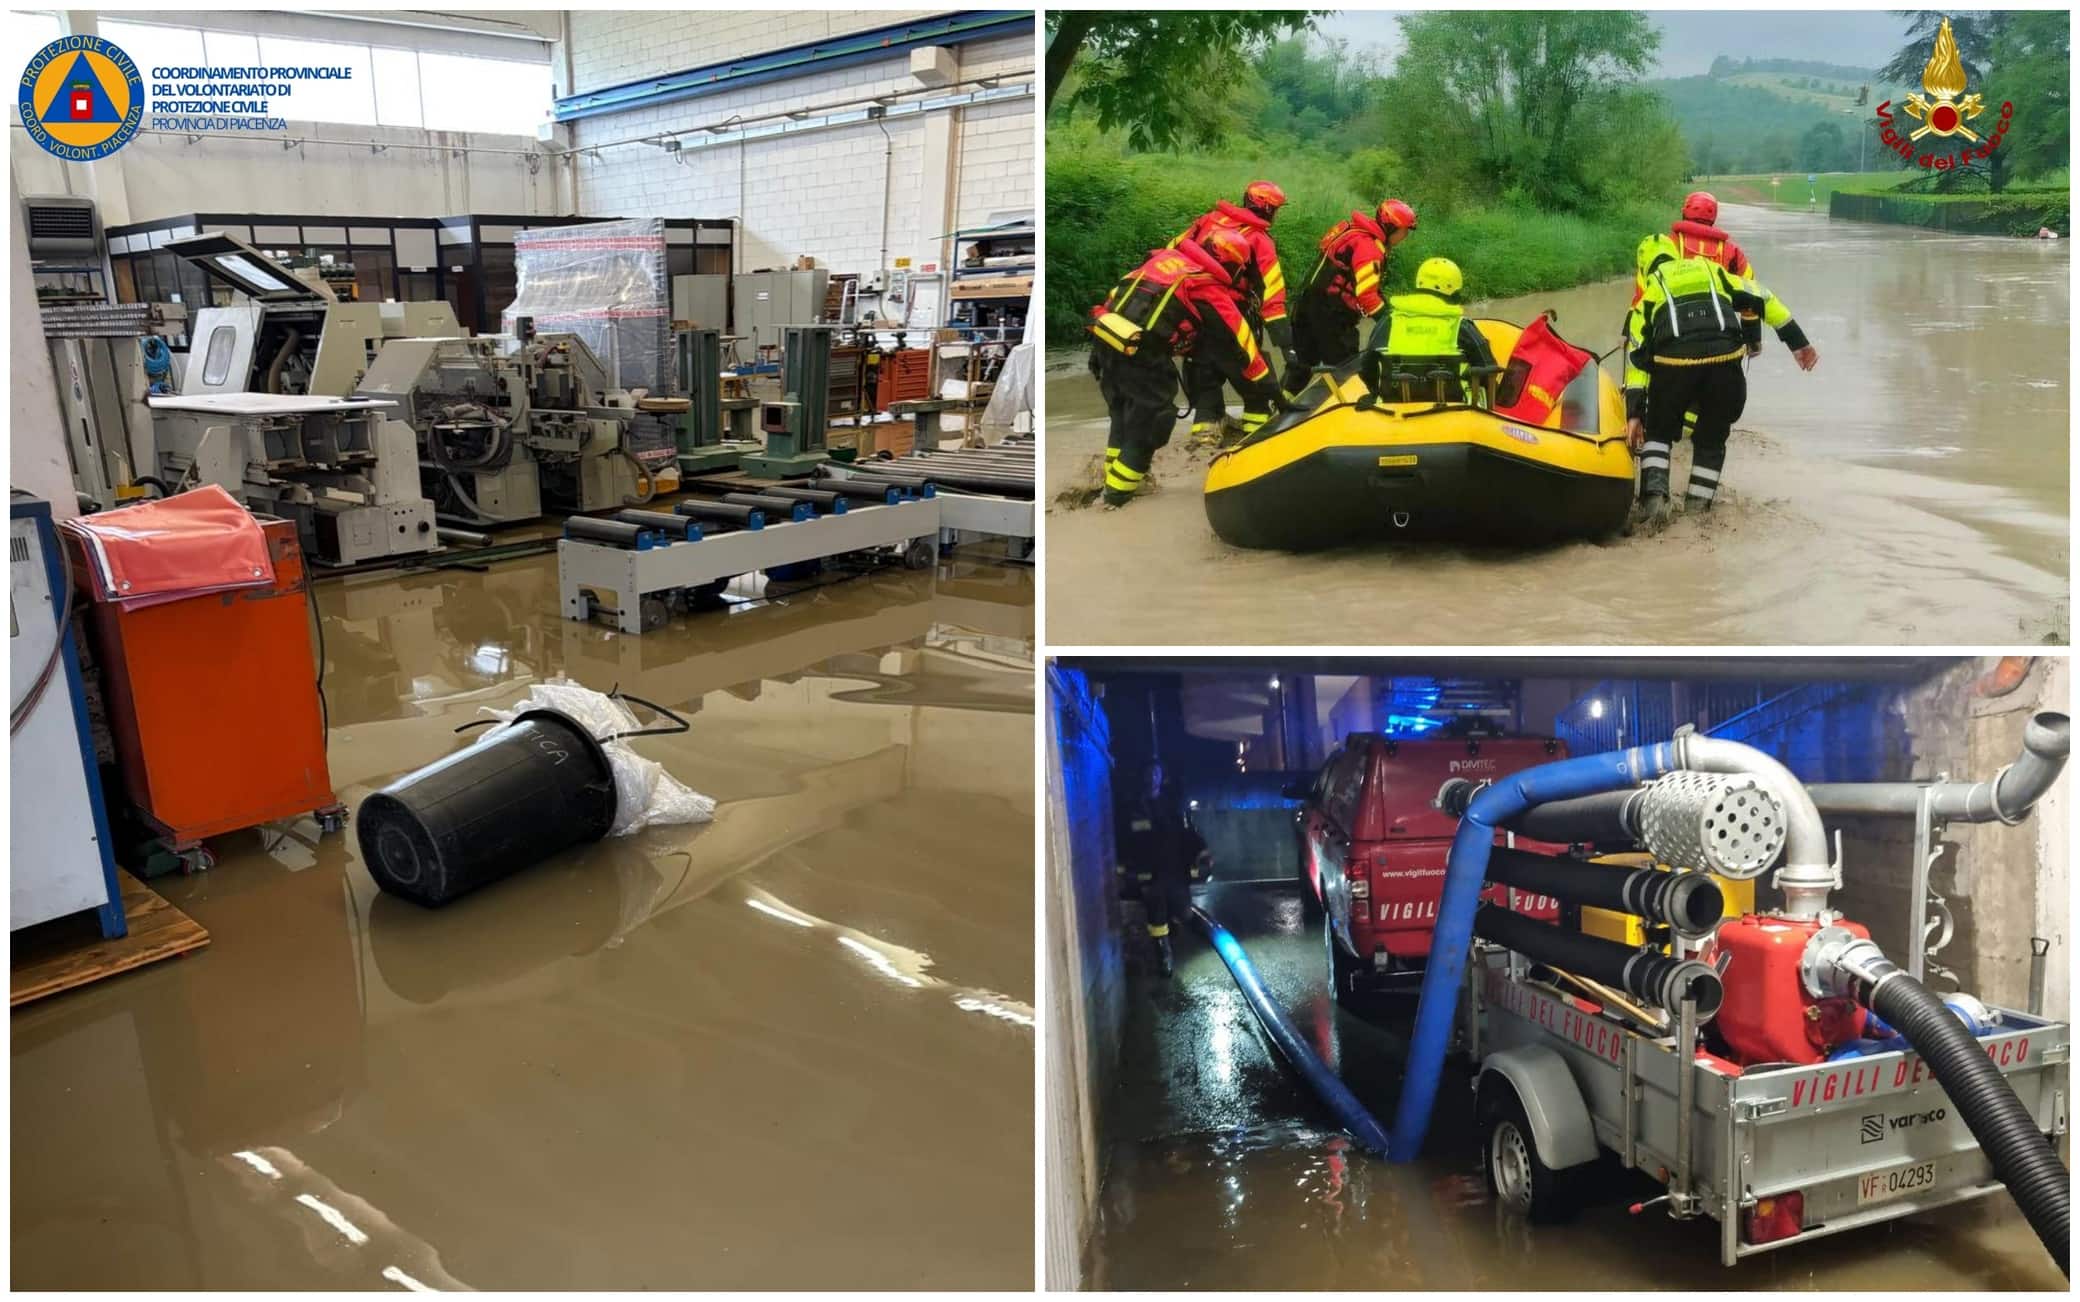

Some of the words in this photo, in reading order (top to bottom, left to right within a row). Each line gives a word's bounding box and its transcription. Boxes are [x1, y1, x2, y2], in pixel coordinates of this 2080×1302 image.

[1380, 901, 1435, 921] VIGIL
[1529, 993, 1556, 1031] DEL
[1562, 1008, 1620, 1061] FUOCO
[1792, 1064, 1881, 1108] VIGILI
[1986, 1037, 2029, 1067] OCO
[1889, 1108, 1946, 1130] varsco
[1862, 1175, 1879, 1199] VF
[1889, 1163, 1934, 1192] 04293
